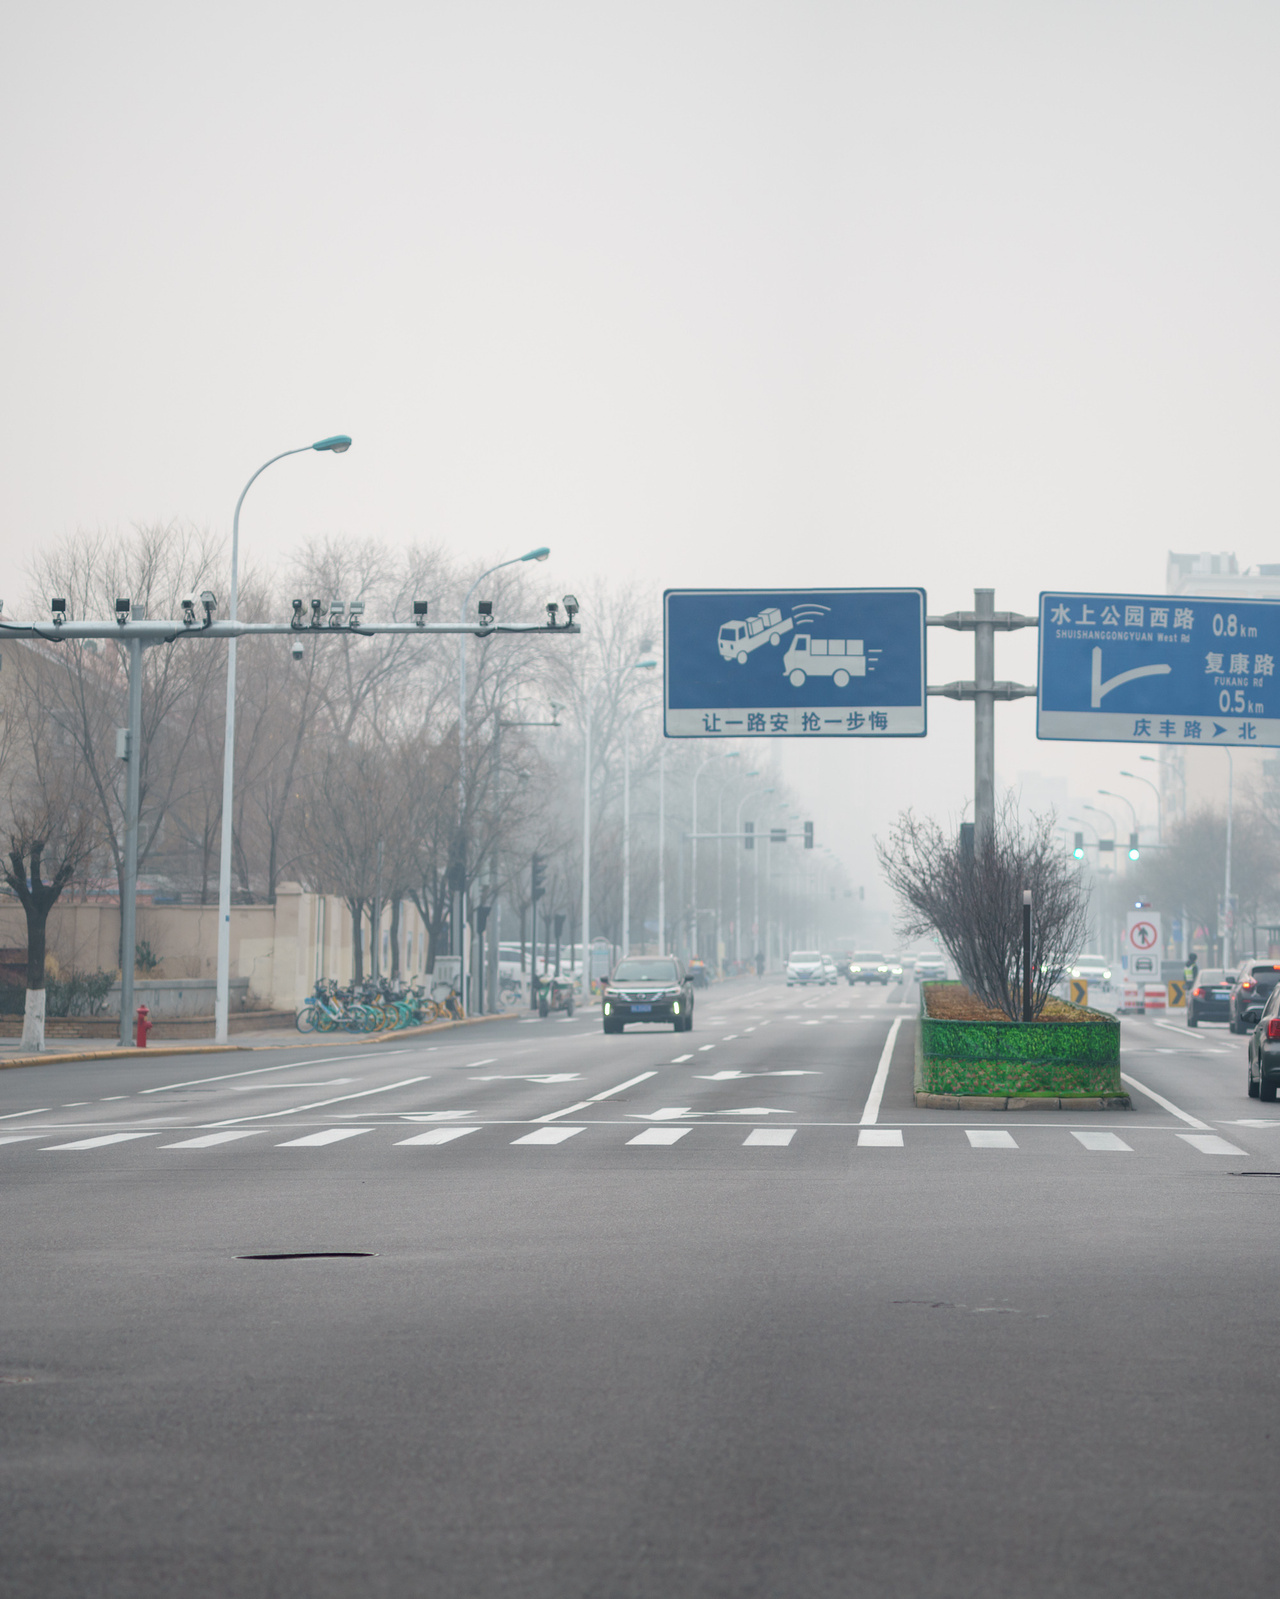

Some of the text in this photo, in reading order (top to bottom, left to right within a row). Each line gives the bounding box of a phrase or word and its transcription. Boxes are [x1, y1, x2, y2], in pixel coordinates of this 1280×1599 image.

[1050, 603, 1195, 631] 水上公园西路
[1055, 629, 1191, 643] SHUISHANGGONGYUAN West Rd
[1204, 652, 1275, 677] 复康路
[1214, 676, 1263, 688] FUKANG Rd
[702, 710, 889, 732] 让一路安 抢一步悔
[1133, 718, 1257, 740] 庆丰路 北
